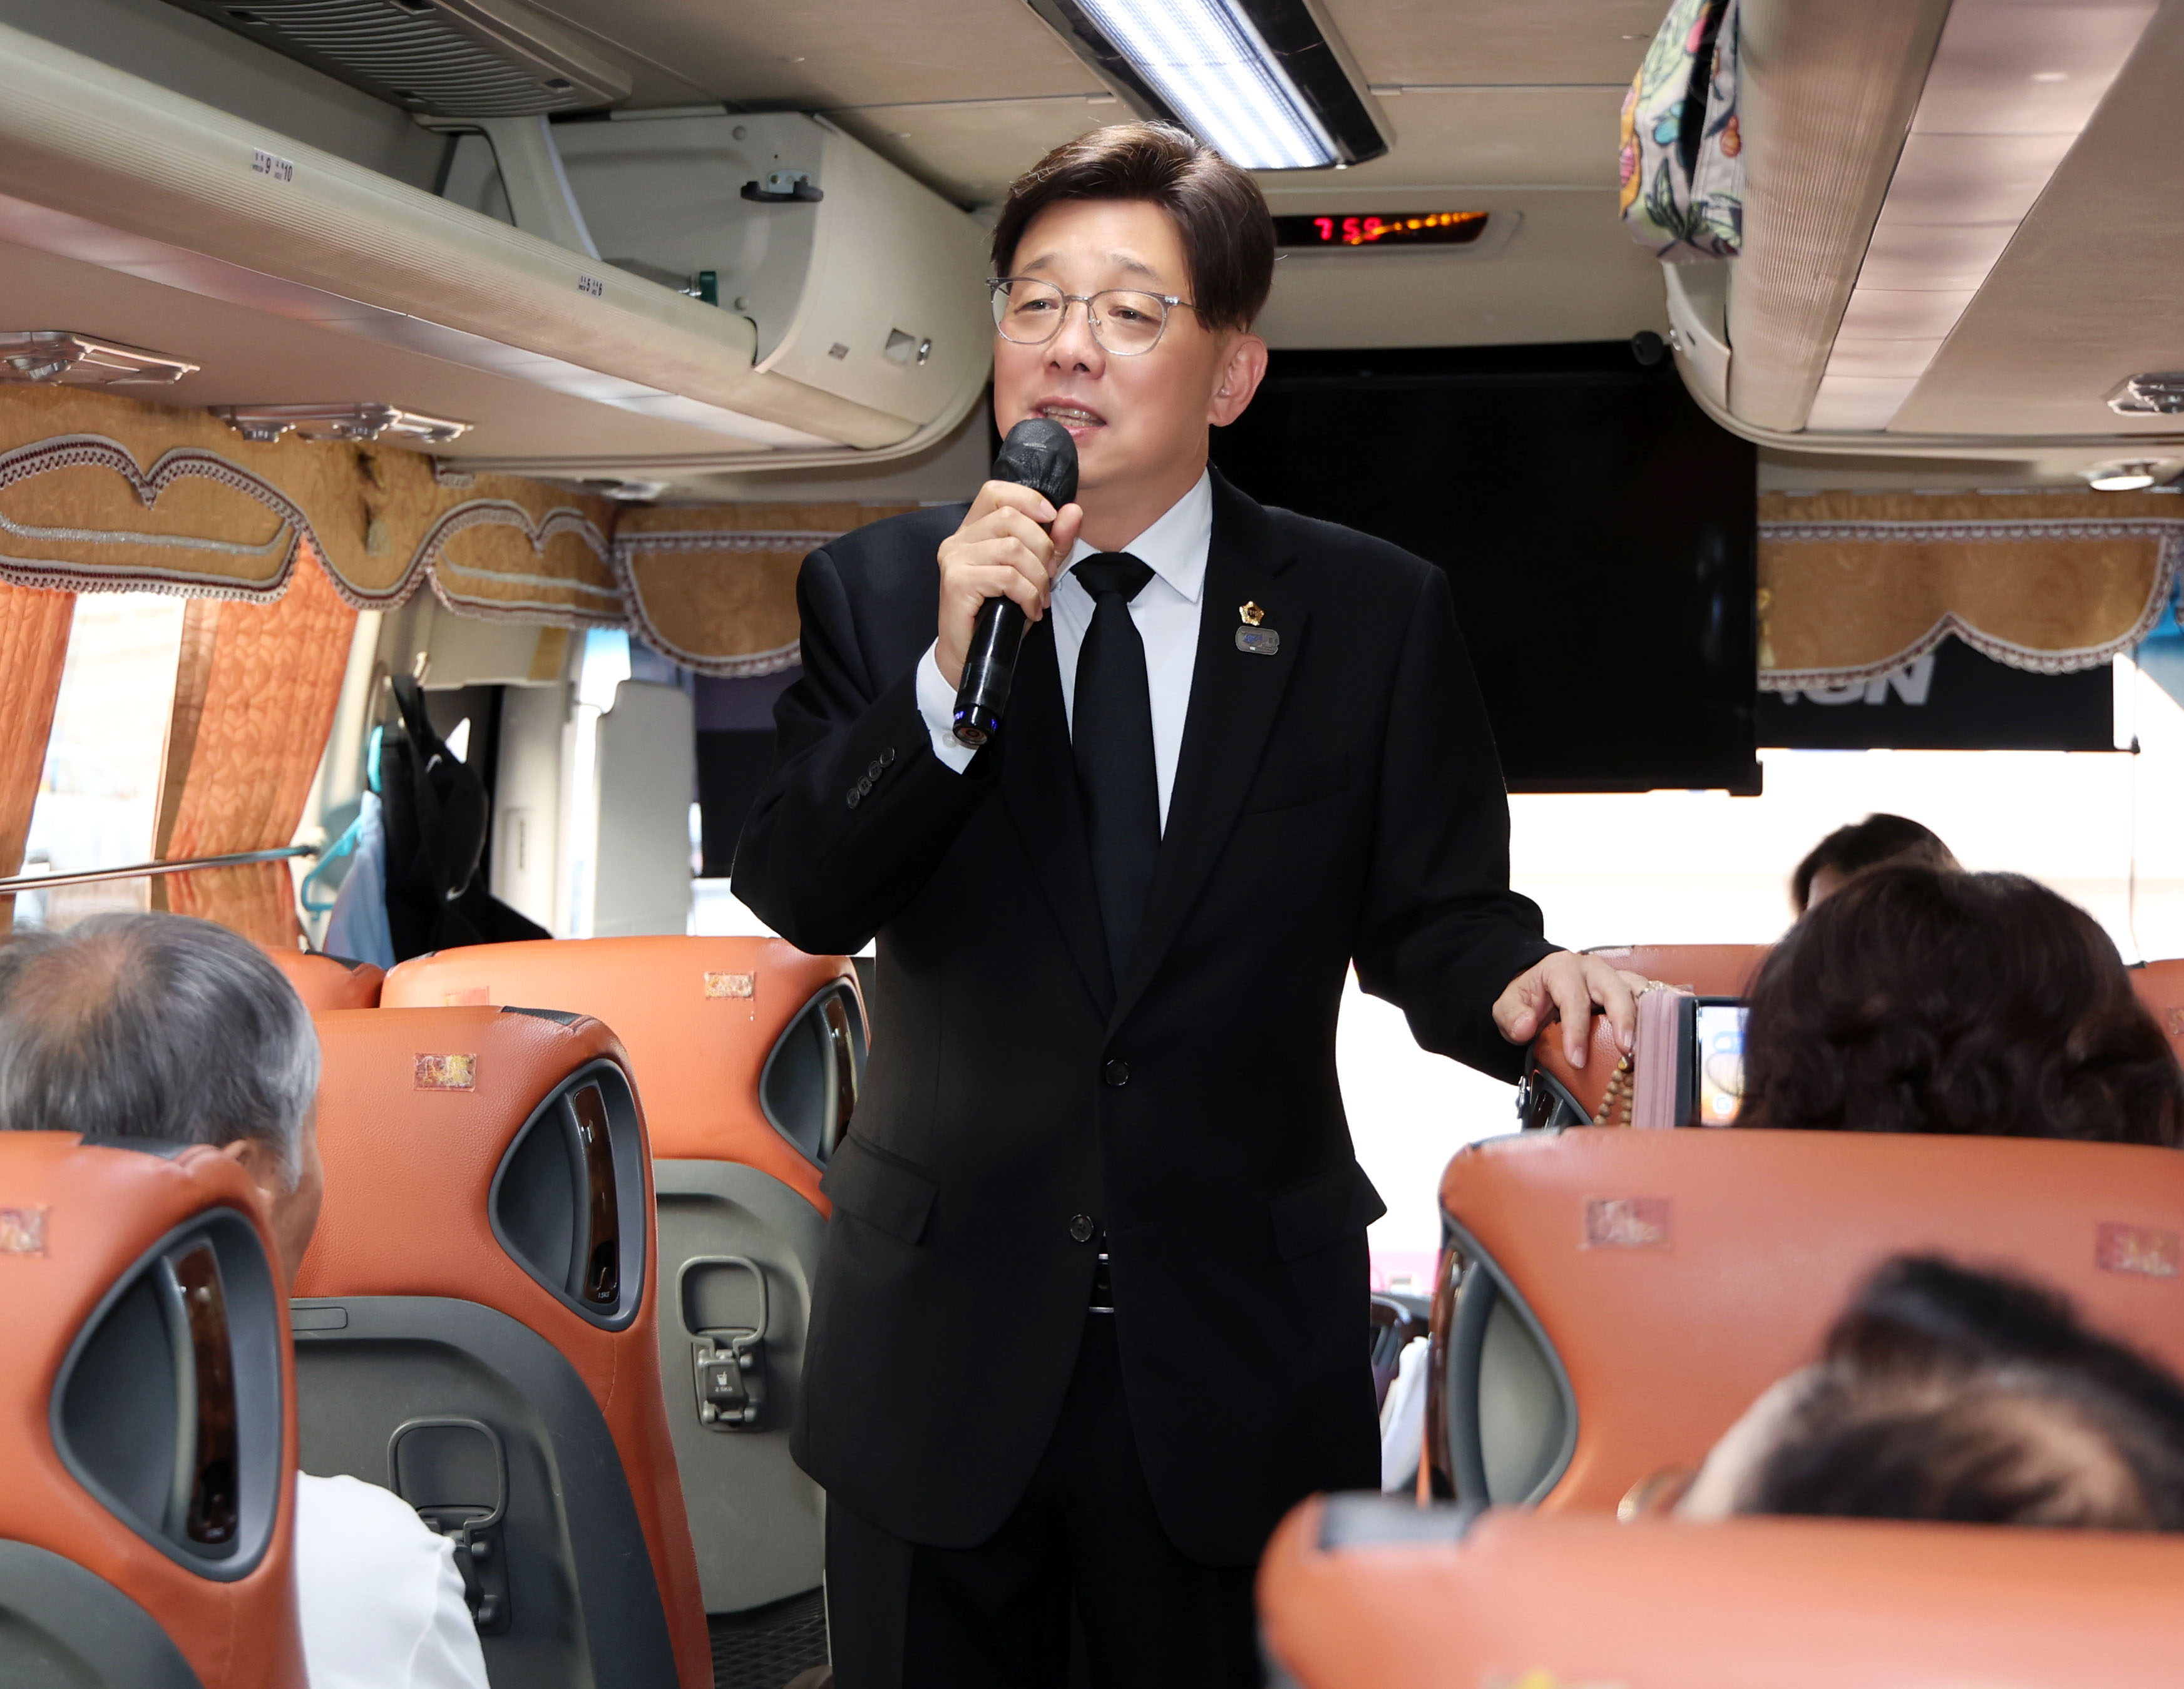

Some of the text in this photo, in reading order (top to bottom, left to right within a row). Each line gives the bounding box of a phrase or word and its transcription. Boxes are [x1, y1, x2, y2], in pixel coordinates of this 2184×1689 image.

[265, 157, 271, 174] 9
[284, 165, 292, 181] 10
[586, 278, 590, 292] 5
[598, 282, 602, 296] 6
